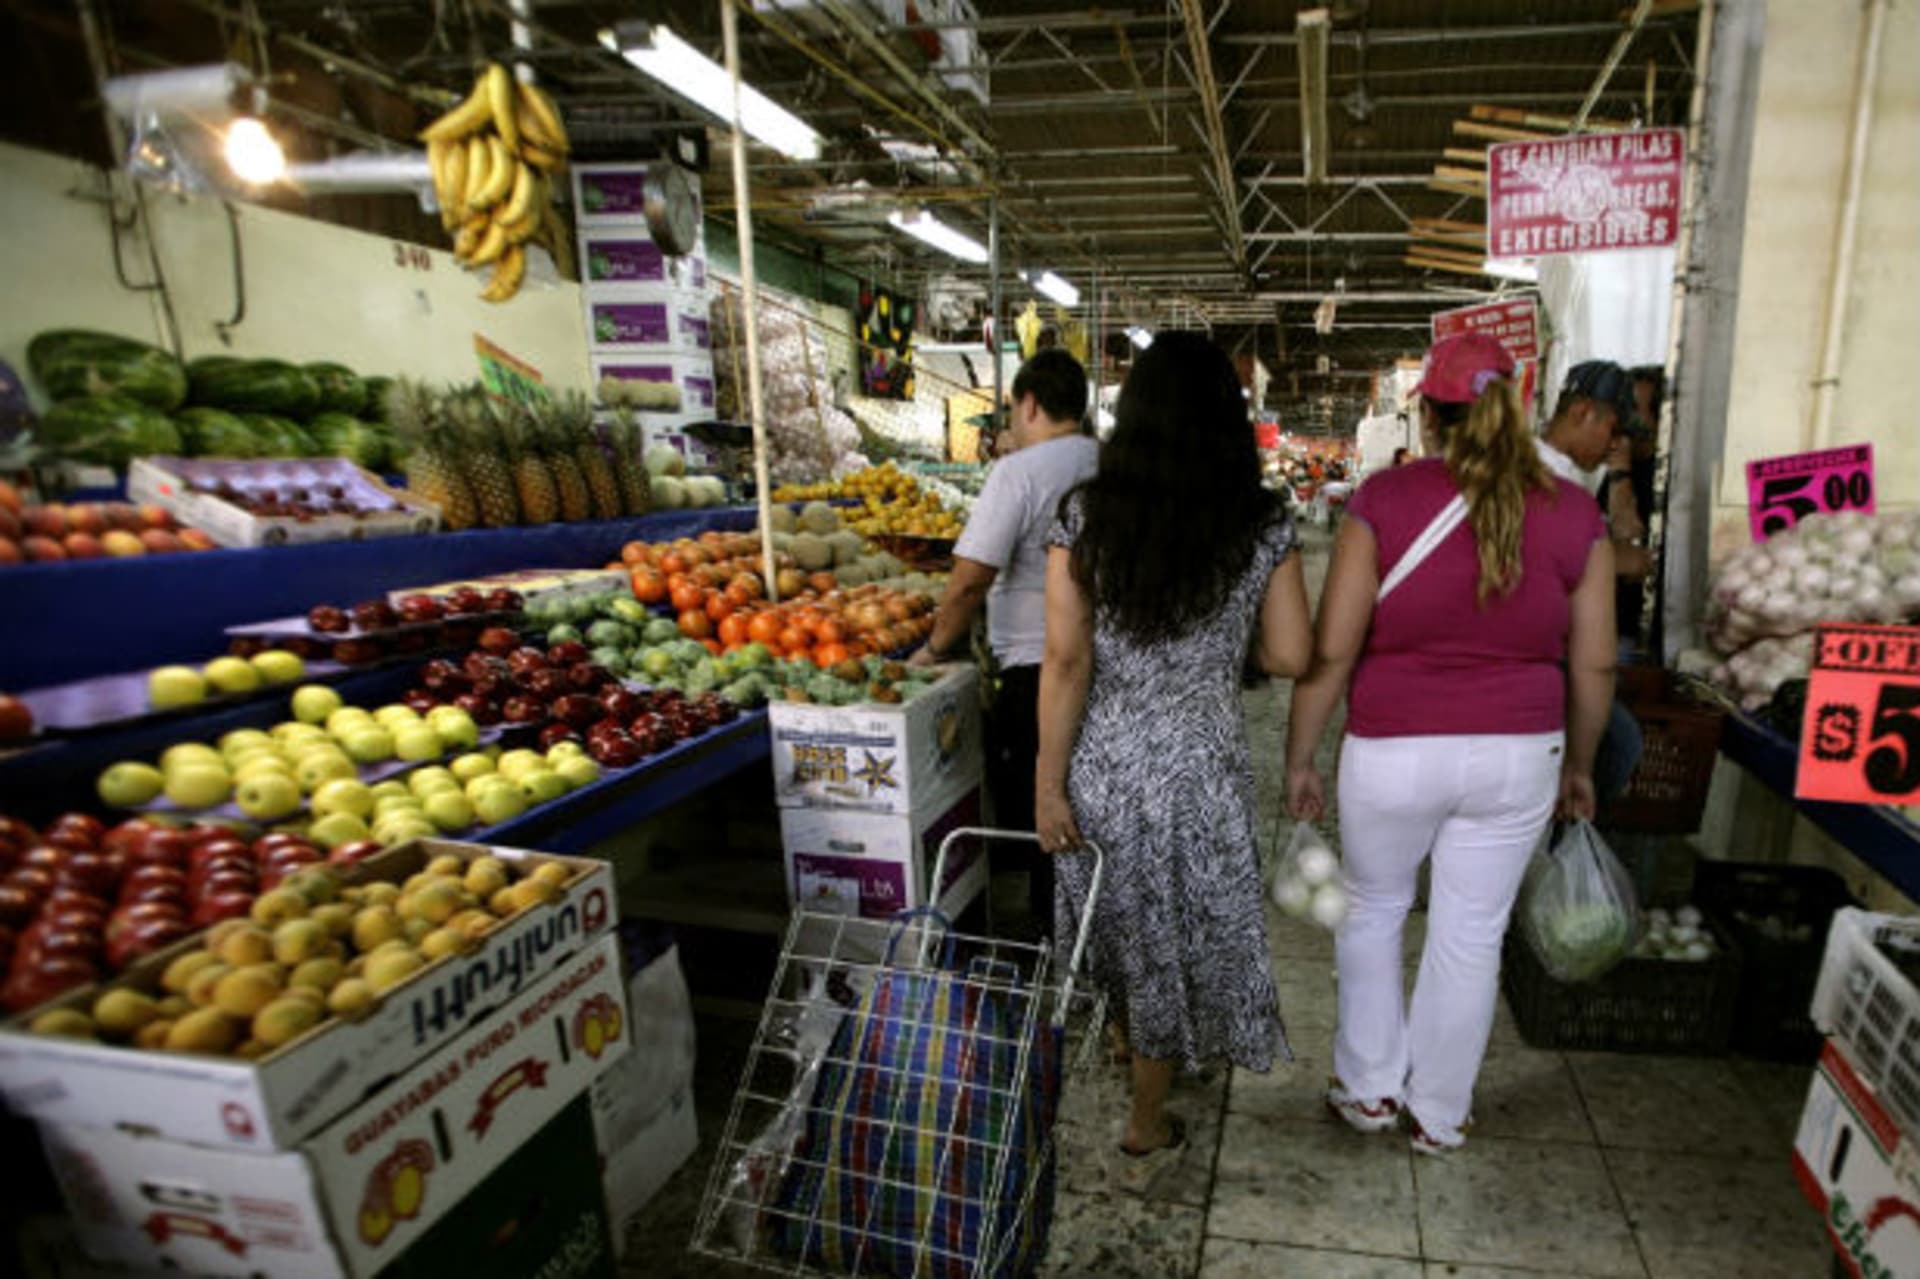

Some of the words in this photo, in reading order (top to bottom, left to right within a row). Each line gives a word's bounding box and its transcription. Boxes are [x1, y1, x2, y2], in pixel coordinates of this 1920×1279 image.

[1501, 148, 1521, 172] SE
[1618, 132, 1673, 161] PILAS
[1500, 216, 1670, 253] EXTENSIBLES
[463, 1019, 516, 1071] PURO
